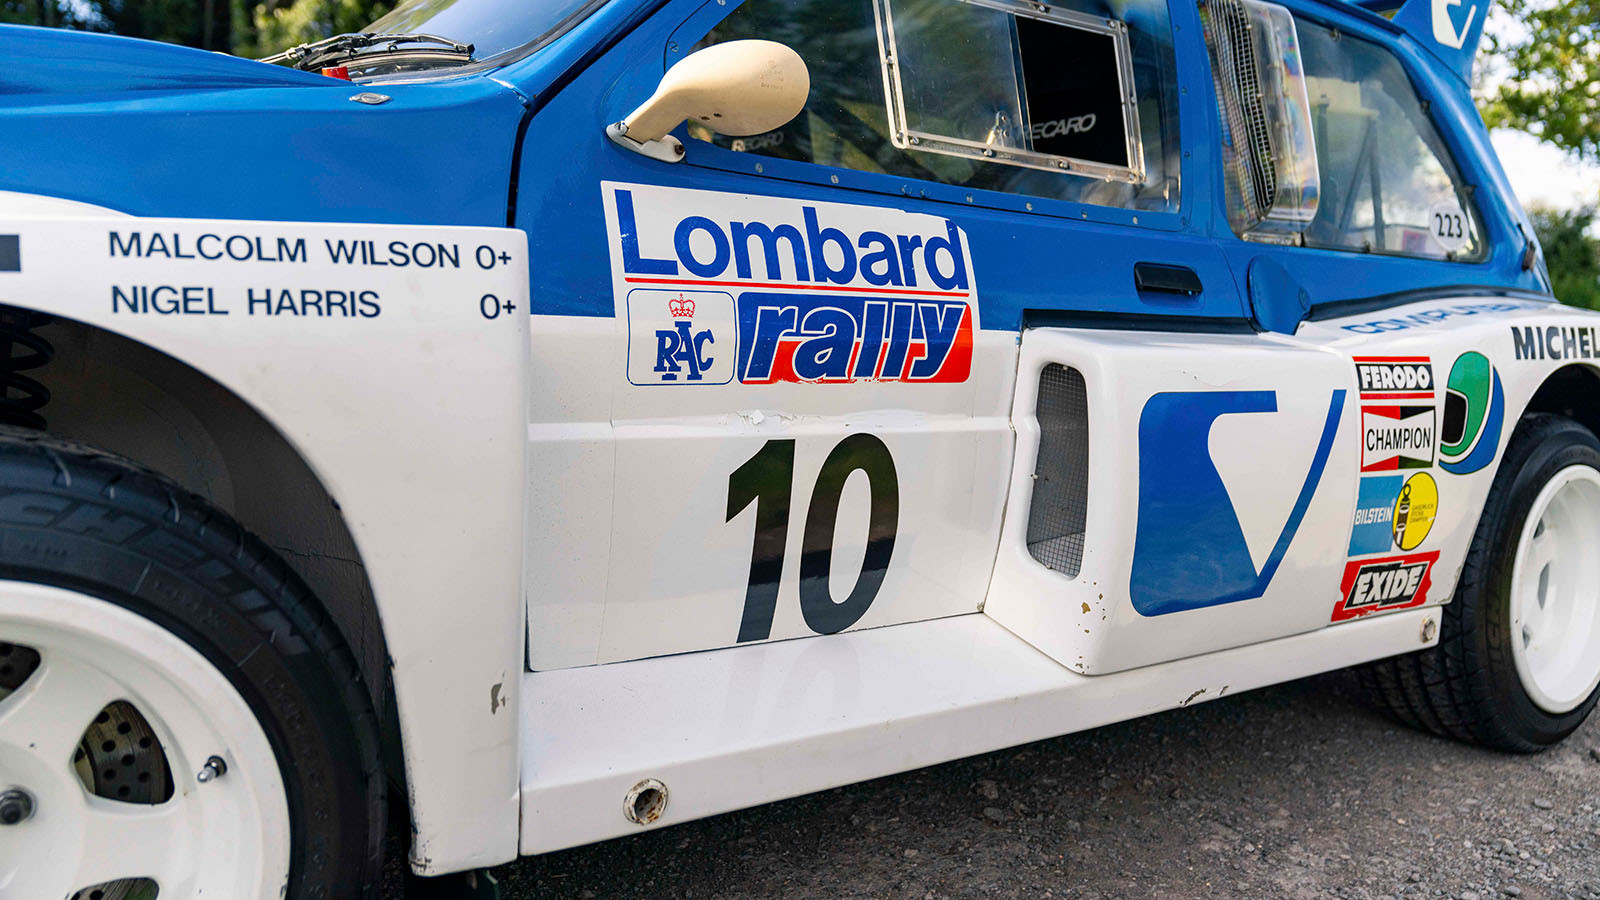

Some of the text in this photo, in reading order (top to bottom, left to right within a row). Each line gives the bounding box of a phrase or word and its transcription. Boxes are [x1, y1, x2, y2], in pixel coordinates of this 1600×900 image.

[614, 188, 970, 291] Lombard
[1435, 212, 1463, 238] 223
[109, 231, 308, 263] MALCOLM
[324, 238, 461, 269] WILSON
[111, 285, 230, 316] NIGEL
[247, 288, 381, 319] HARRIS
[653, 320, 715, 382] RAC
[742, 300, 968, 382] rally
[1510, 326, 1600, 360] MICHEL
[1359, 365, 1431, 389] FERODO
[1366, 427, 1431, 452] CHAMPION
[1354, 505, 1394, 526] BILSTEIN
[725, 432, 900, 644] 10
[1351, 564, 1424, 605] EXIDE
